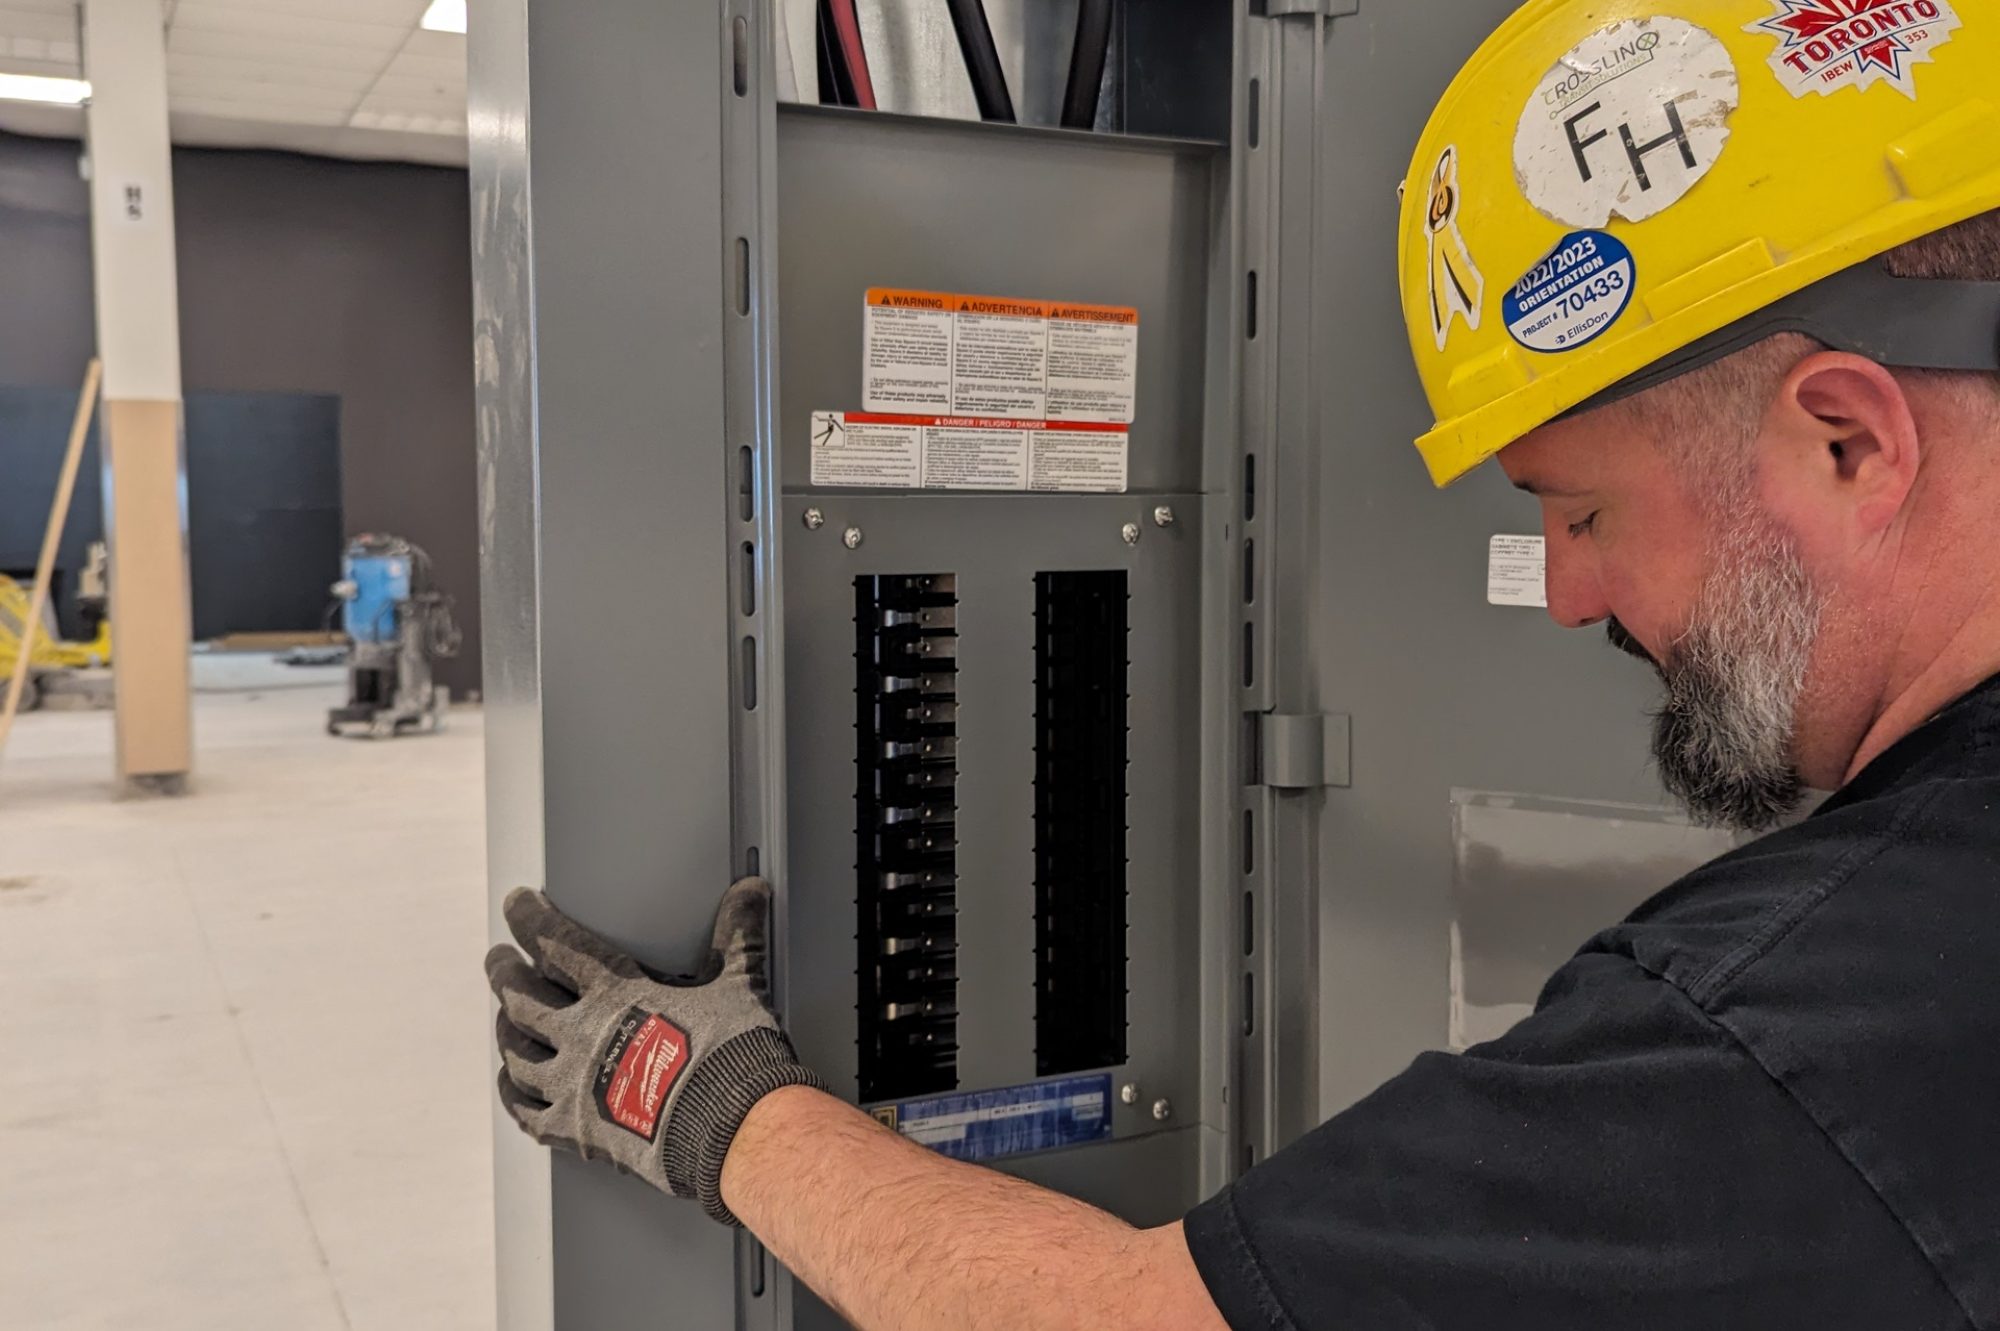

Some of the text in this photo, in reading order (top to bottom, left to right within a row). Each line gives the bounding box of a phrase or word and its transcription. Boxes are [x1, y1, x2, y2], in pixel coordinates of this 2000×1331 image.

[1783, 0, 1939, 75] TORONTO
[1821, 29, 1929, 83] IBEW 353
[1594, 53, 1647, 83] SOLUTIONS
[1513, 236, 1597, 300] 2022/2023
[1519, 255, 1604, 312] ORIENTATION
[893, 296, 943, 309] WARNING
[971, 302, 1043, 317] ADVERTENCIA
[1061, 309, 1134, 323] AVERTISSEMENT
[1522, 315, 1553, 339] PROJECT
[1555, 270, 1624, 319] 70433
[1567, 311, 1609, 340] EllisDon
[943, 418, 974, 427] DANGER
[980, 420, 1011, 428] PELIGRO
[1016, 421, 1047, 429] DANGER
[644, 1038, 679, 1113] Milwaukee
